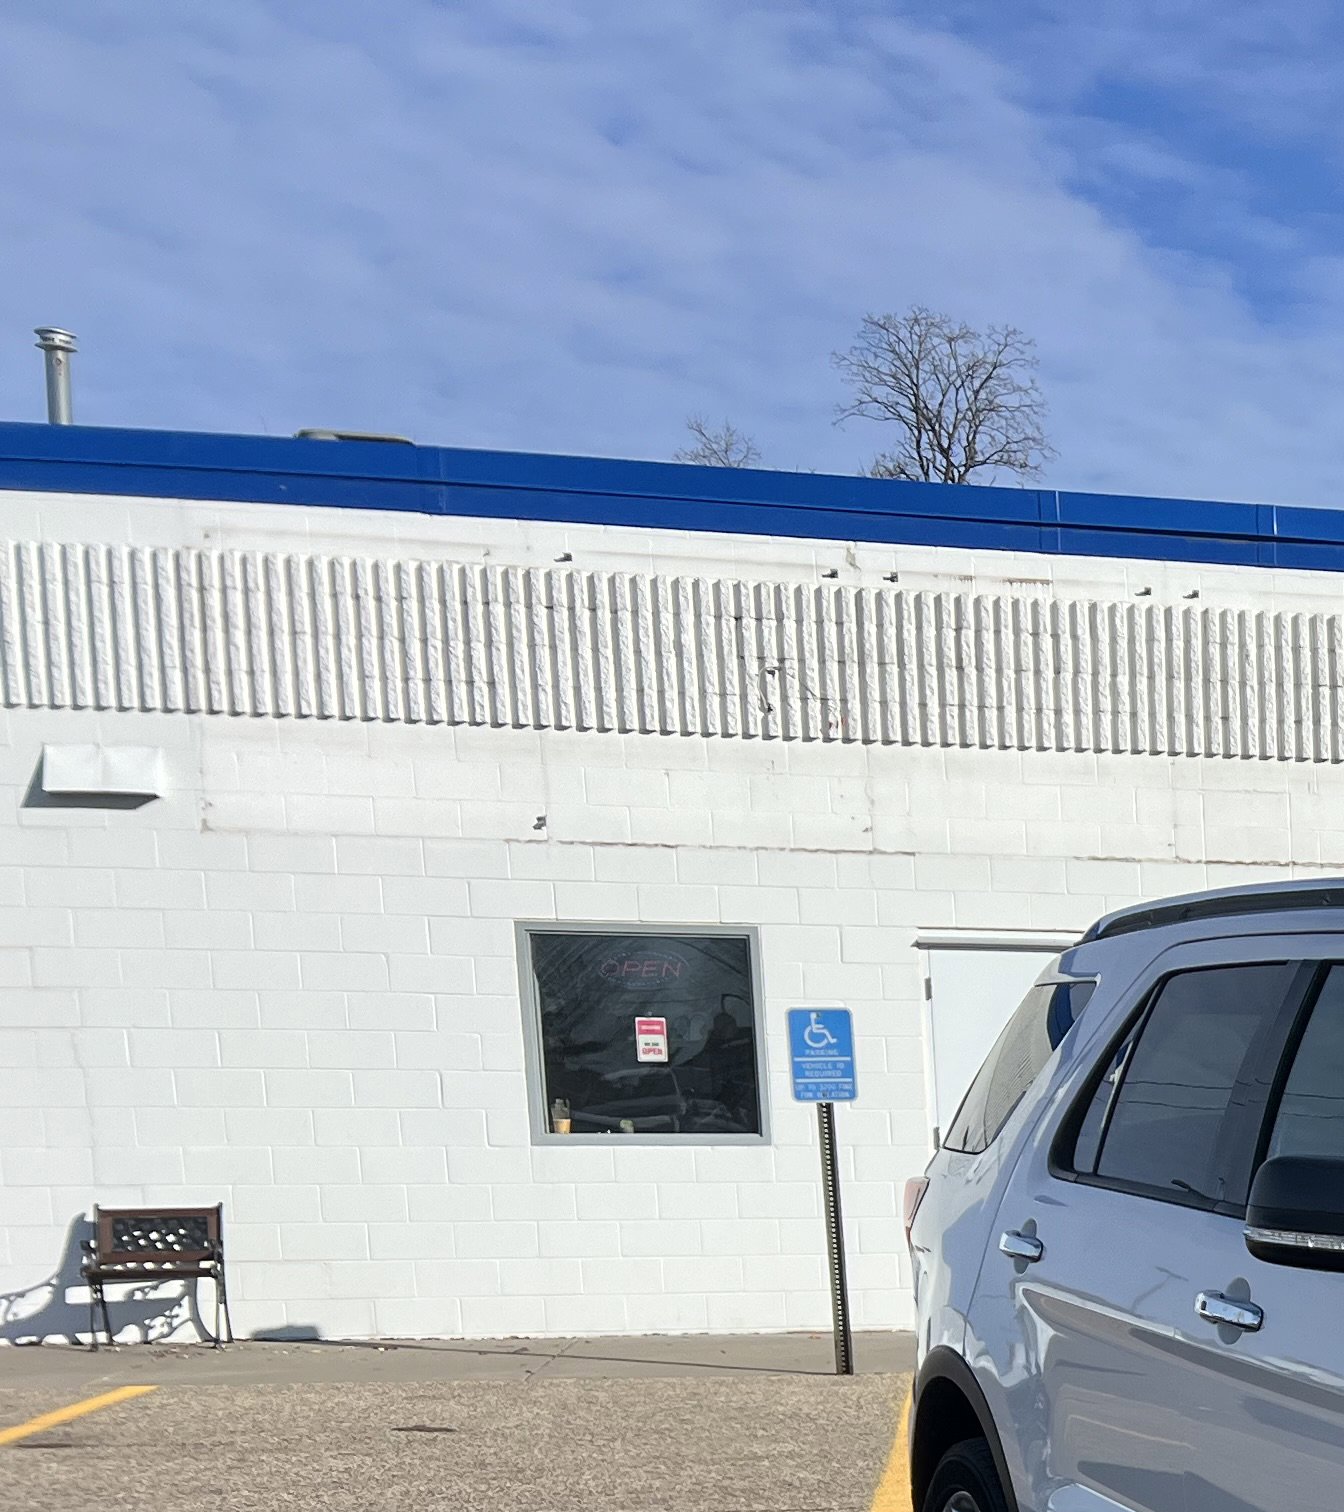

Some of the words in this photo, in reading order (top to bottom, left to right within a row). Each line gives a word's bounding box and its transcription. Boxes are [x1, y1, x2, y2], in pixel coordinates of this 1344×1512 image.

[600, 960, 682, 977] OPEN
[642, 1047, 663, 1055] OPEN
[805, 1048, 839, 1056] PARKING
[802, 1062, 832, 1070] VEHICLE
[805, 1070, 842, 1078] REQUIRED
